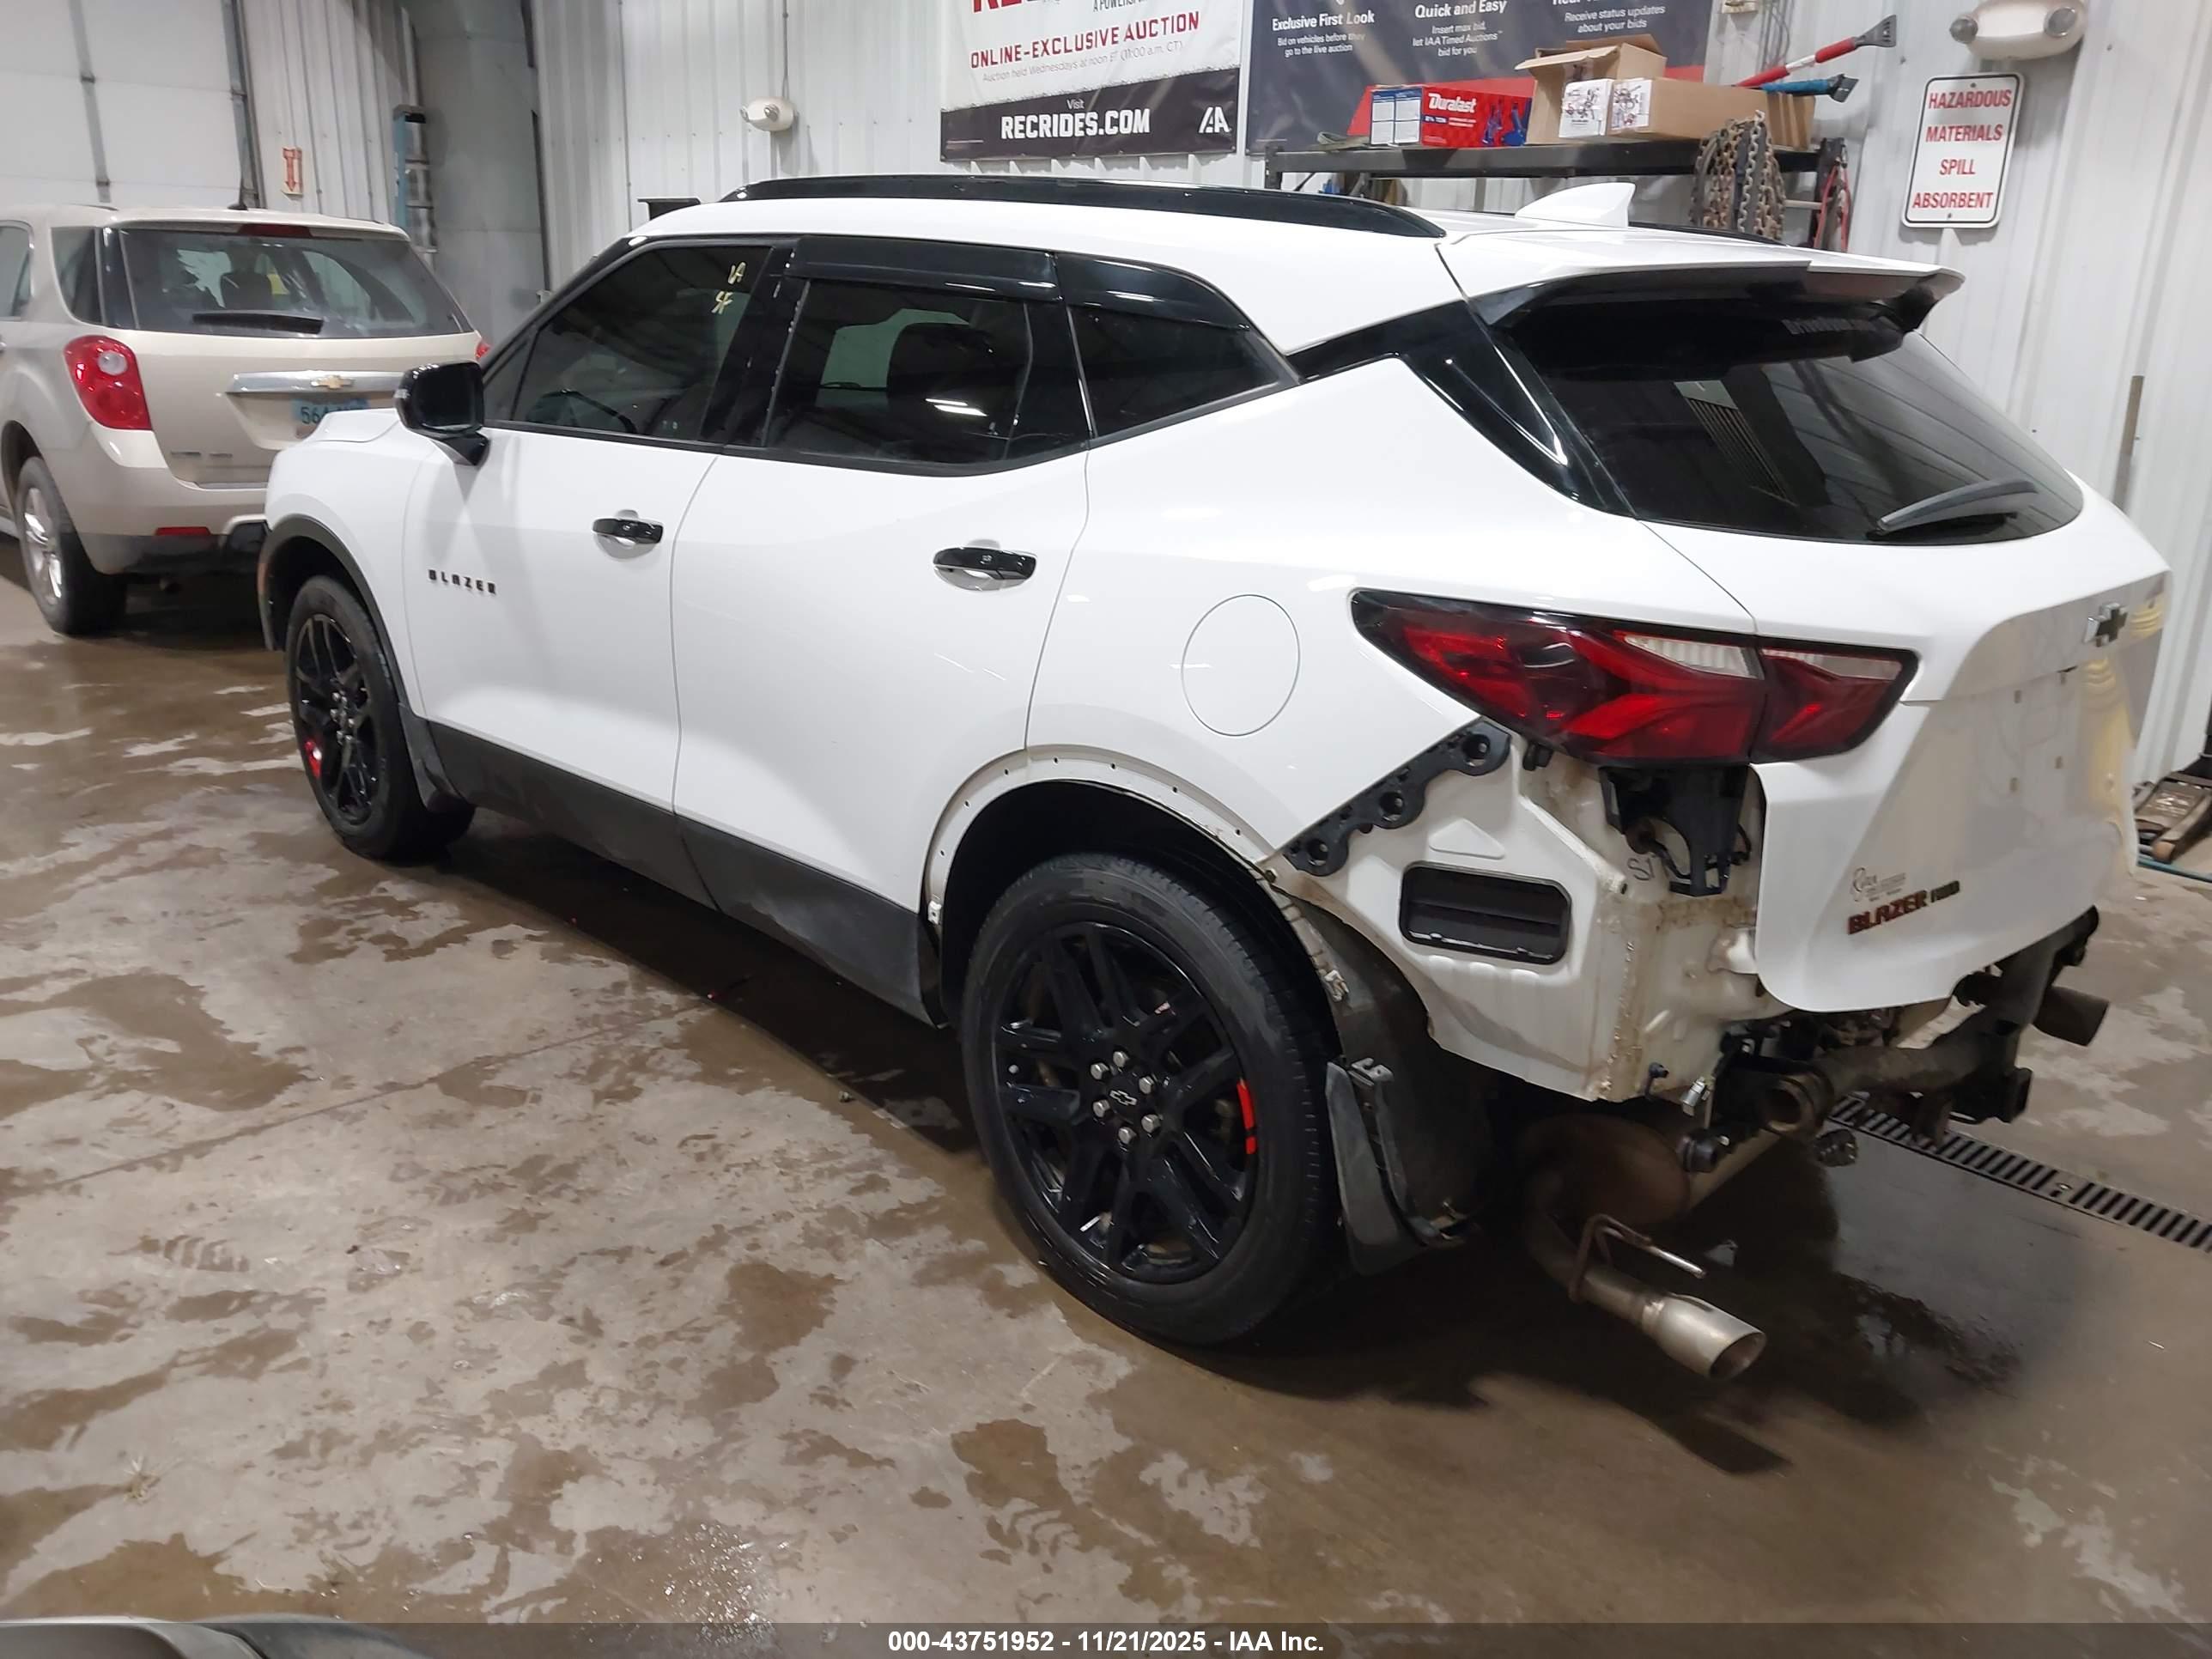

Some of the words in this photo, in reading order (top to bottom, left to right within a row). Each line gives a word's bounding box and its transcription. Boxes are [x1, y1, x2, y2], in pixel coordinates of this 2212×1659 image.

[1414, 3, 1451, 18] Quick
[1453, 0, 1476, 15] and
[1478, 0, 1508, 14] Easy
[1565, 10, 1597, 21] Receive
[1599, 8, 1626, 19] status
[1627, 5, 1666, 18] updates
[1272, 15, 1316, 31] Exclusive
[1319, 13, 1343, 27] First
[1346, 9, 1375, 24] Look
[1431, 25, 1454, 34] Insert
[1455, 24, 1471, 33] max
[1577, 21, 1602, 33] about
[1603, 21, 1625, 33] your
[1627, 18, 1647, 29] bids
[970, 27, 1120, 69] ONLINE-EXCLUSIVE
[1123, 11, 1200, 41] AUCTION
[1277, 37, 1287, 46] Bid
[1297, 34, 1324, 45] vehicles
[1325, 33, 1347, 43] before
[1413, 37, 1424, 46] let
[1425, 36, 1441, 46] IAA
[1442, 34, 1464, 45] Timed
[1285, 48, 1293, 58] go
[1294, 46, 1301, 55] to
[1302, 46, 1313, 55] the
[1314, 45, 1327, 53] live
[1328, 43, 1352, 53] auction
[1437, 47, 1450, 57] bid
[1451, 46, 1462, 55] for
[1462, 47, 1478, 57] you
[1066, 99, 1085, 110] Visit
[1428, 92, 1477, 113] Duralast
[1929, 89, 2013, 109] HAZARDOUS
[1000, 108, 1152, 140] RECRIDES.COM
[1925, 124, 2004, 143] MATERIALS
[1939, 158, 1977, 176] SPILL
[1911, 191, 1995, 209] ABSORBENT
[428, 568, 497, 594] BLAZER
[1847, 890, 1929, 934] BLAZER
